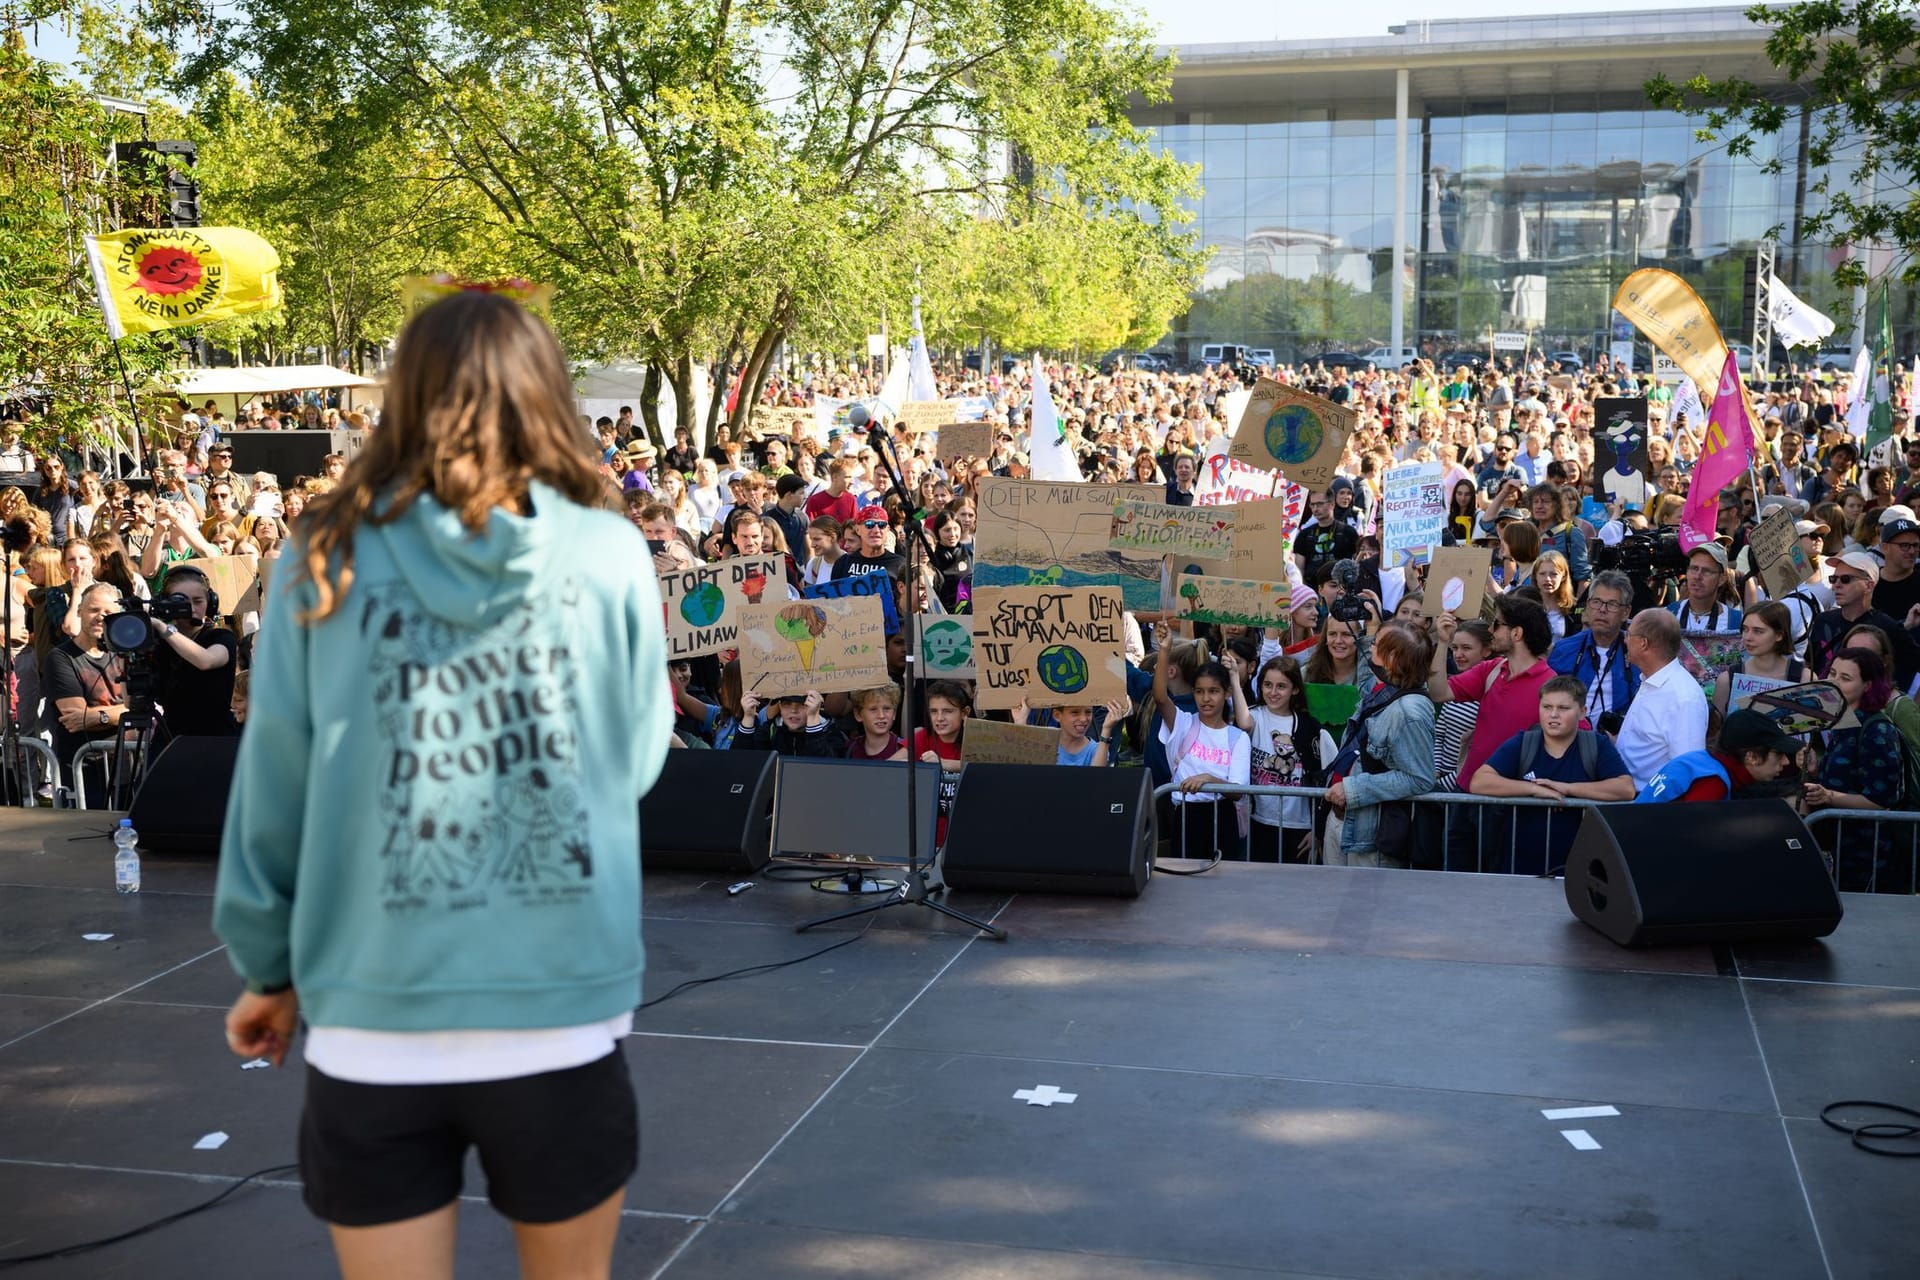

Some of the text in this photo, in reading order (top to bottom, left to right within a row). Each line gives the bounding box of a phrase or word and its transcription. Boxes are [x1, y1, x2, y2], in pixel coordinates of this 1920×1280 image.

[117, 229, 212, 275] ATOMKRAFT?
[134, 266, 221, 318] NEIN DANKE
[1495, 335, 1525, 343] SPENDEN
[990, 486, 1038, 507] DER
[1385, 521, 1413, 537] NUR
[660, 560, 777, 597] TOPT DEN
[847, 562, 886, 576] ALOH
[1088, 592, 1123, 621] DEN
[989, 614, 1120, 644] KLIMAWANDEL
[981, 642, 1014, 666] TUT
[410, 684, 553, 742] to the
[387, 722, 568, 789] people
